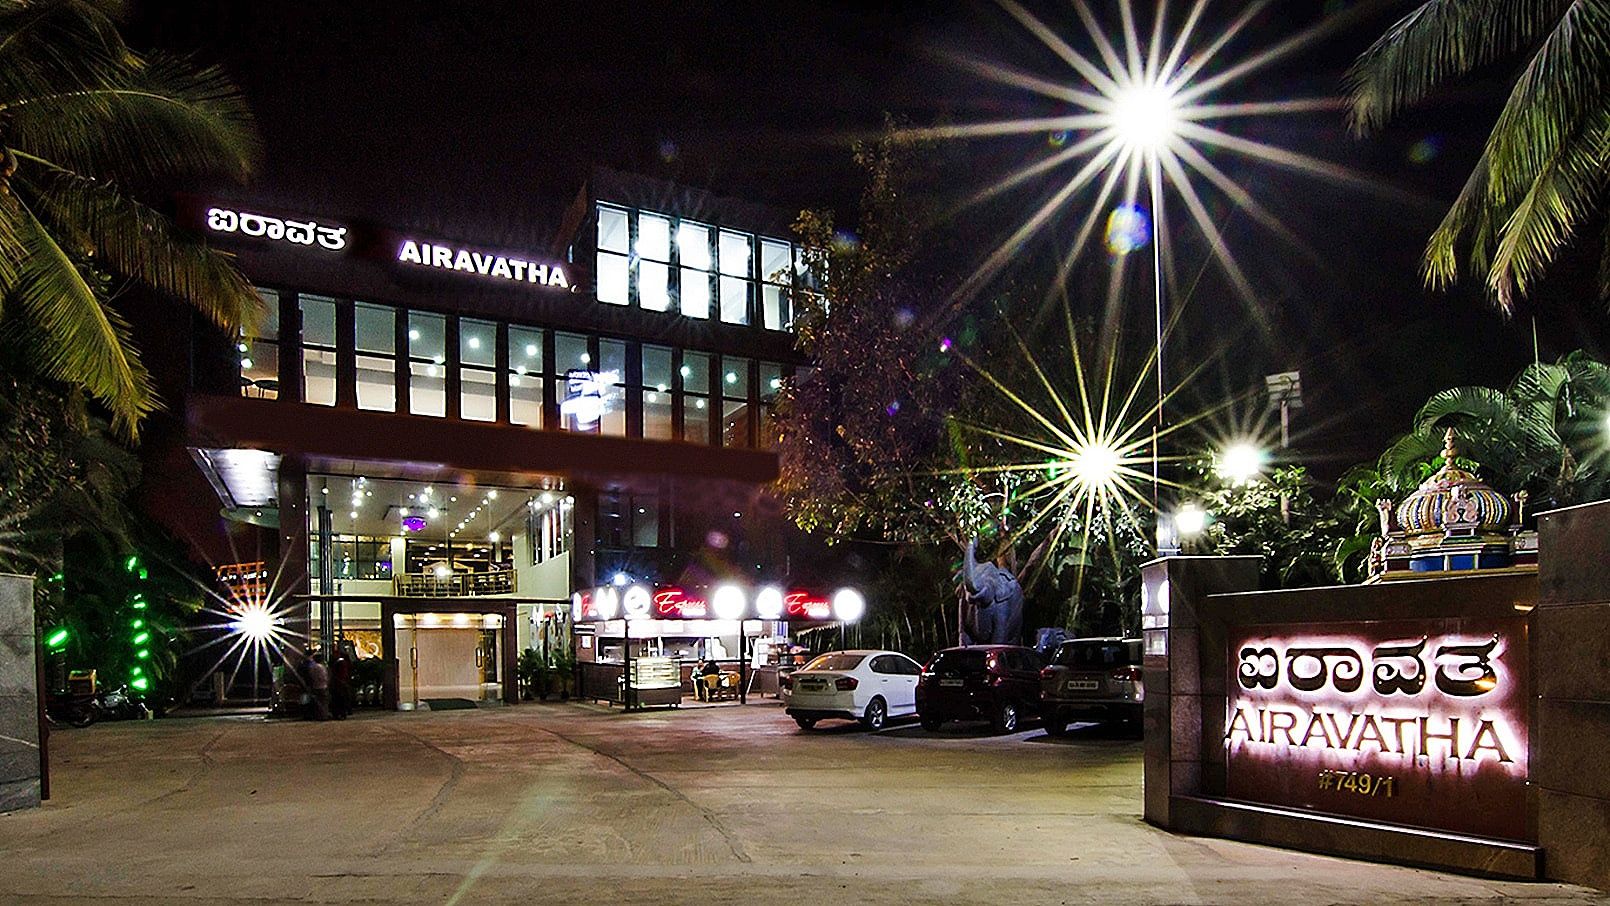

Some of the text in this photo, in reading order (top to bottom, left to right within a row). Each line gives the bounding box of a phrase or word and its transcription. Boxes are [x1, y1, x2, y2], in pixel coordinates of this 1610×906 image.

[207, 207, 347, 250] ಐರಾವತ
[398, 241, 568, 288] AIRAVATHA
[1238, 634, 1499, 696] ಐರಾವತ
[1224, 706, 1515, 764] AIRAVATHA
[1318, 769, 1394, 797] #749/1
